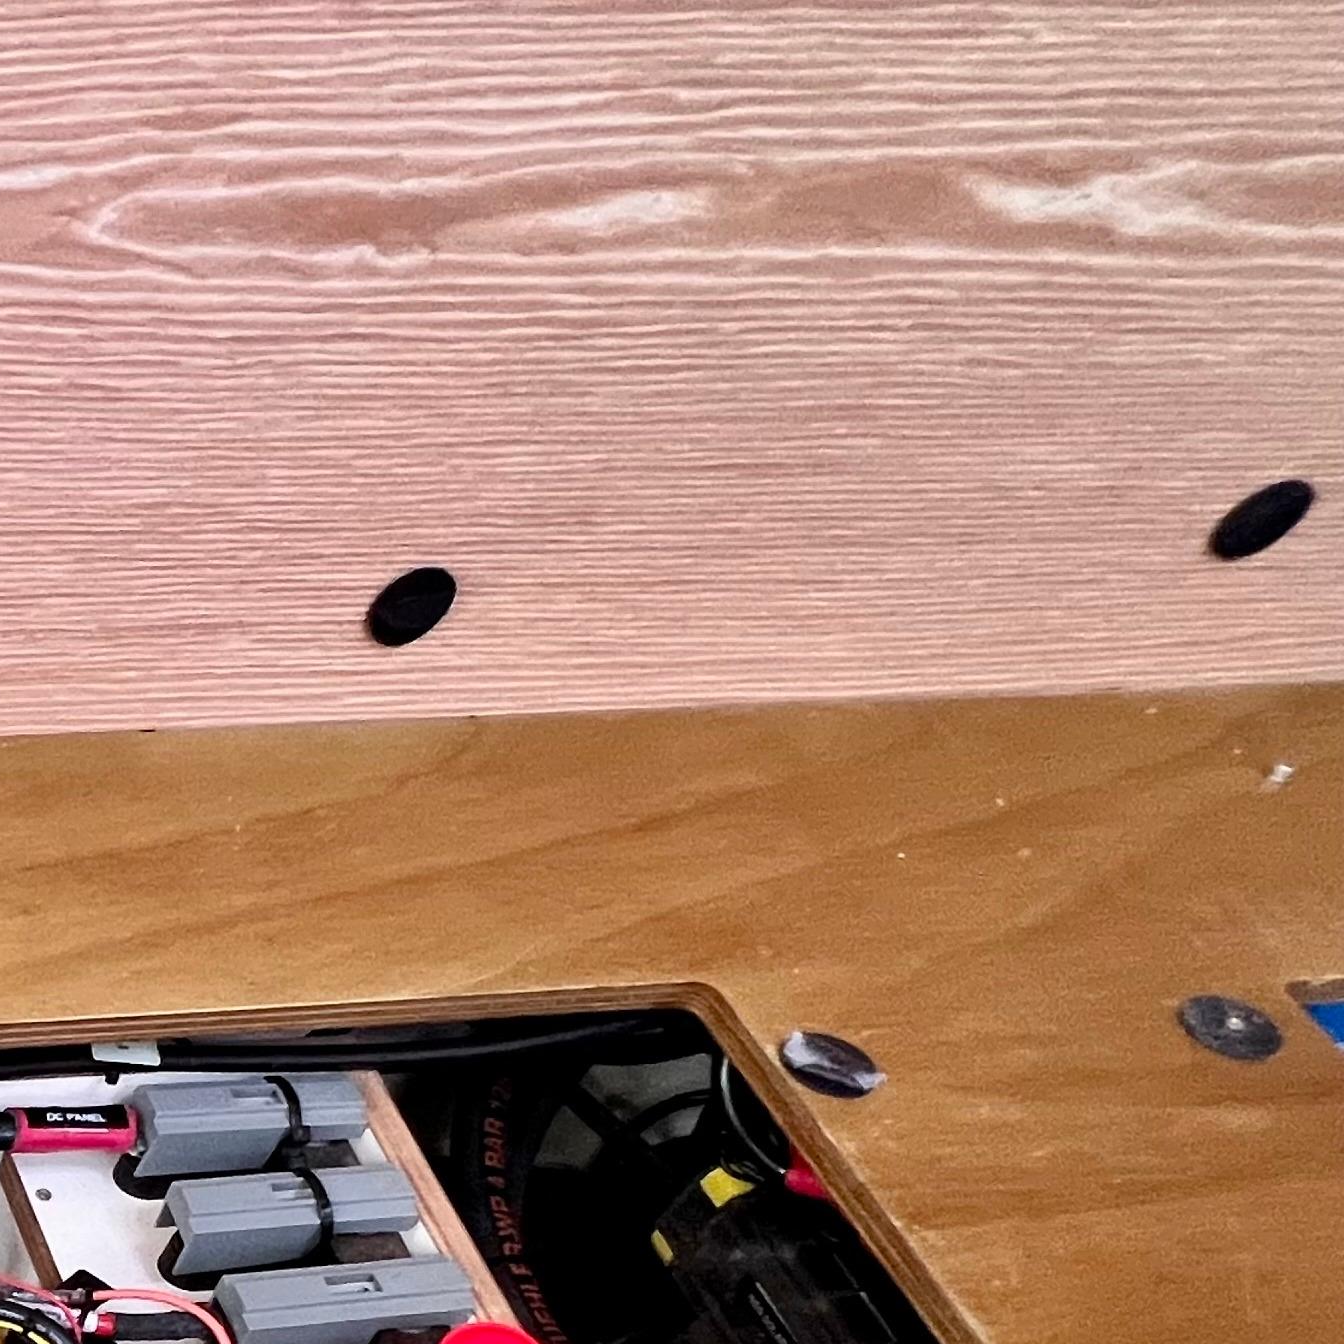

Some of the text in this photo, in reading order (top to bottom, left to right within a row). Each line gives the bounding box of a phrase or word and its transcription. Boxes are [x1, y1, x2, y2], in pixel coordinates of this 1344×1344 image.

[46, 1112, 108, 1122] DC PANEL
[484, 1117, 506, 1169] BAR
